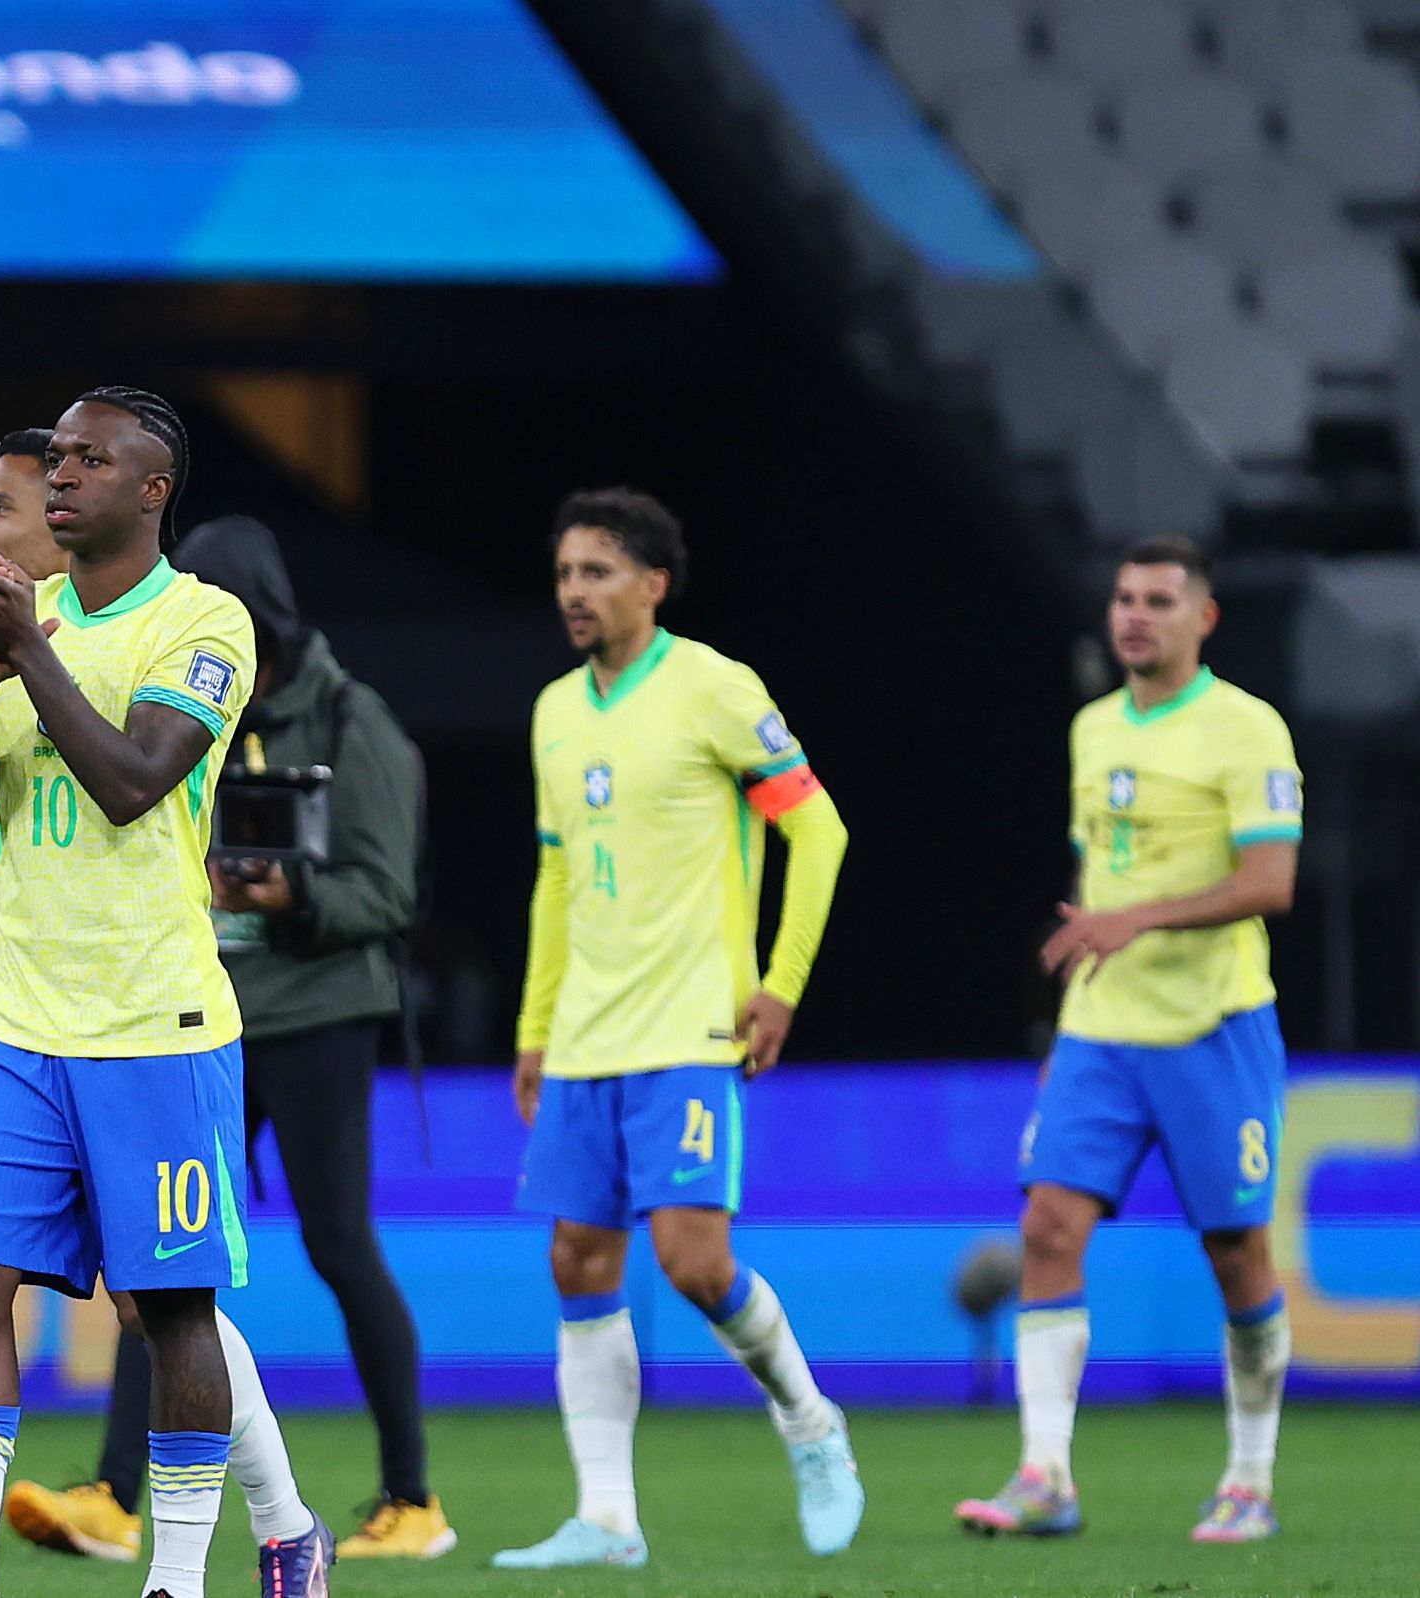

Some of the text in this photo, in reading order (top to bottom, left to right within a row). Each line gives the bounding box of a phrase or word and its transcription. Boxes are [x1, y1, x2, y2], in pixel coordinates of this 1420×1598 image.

[31, 775, 78, 848] 10
[592, 841, 617, 898] 4
[678, 1098, 714, 1161] 4
[1238, 1117, 1270, 1179] 8
[157, 1158, 211, 1233] 10
